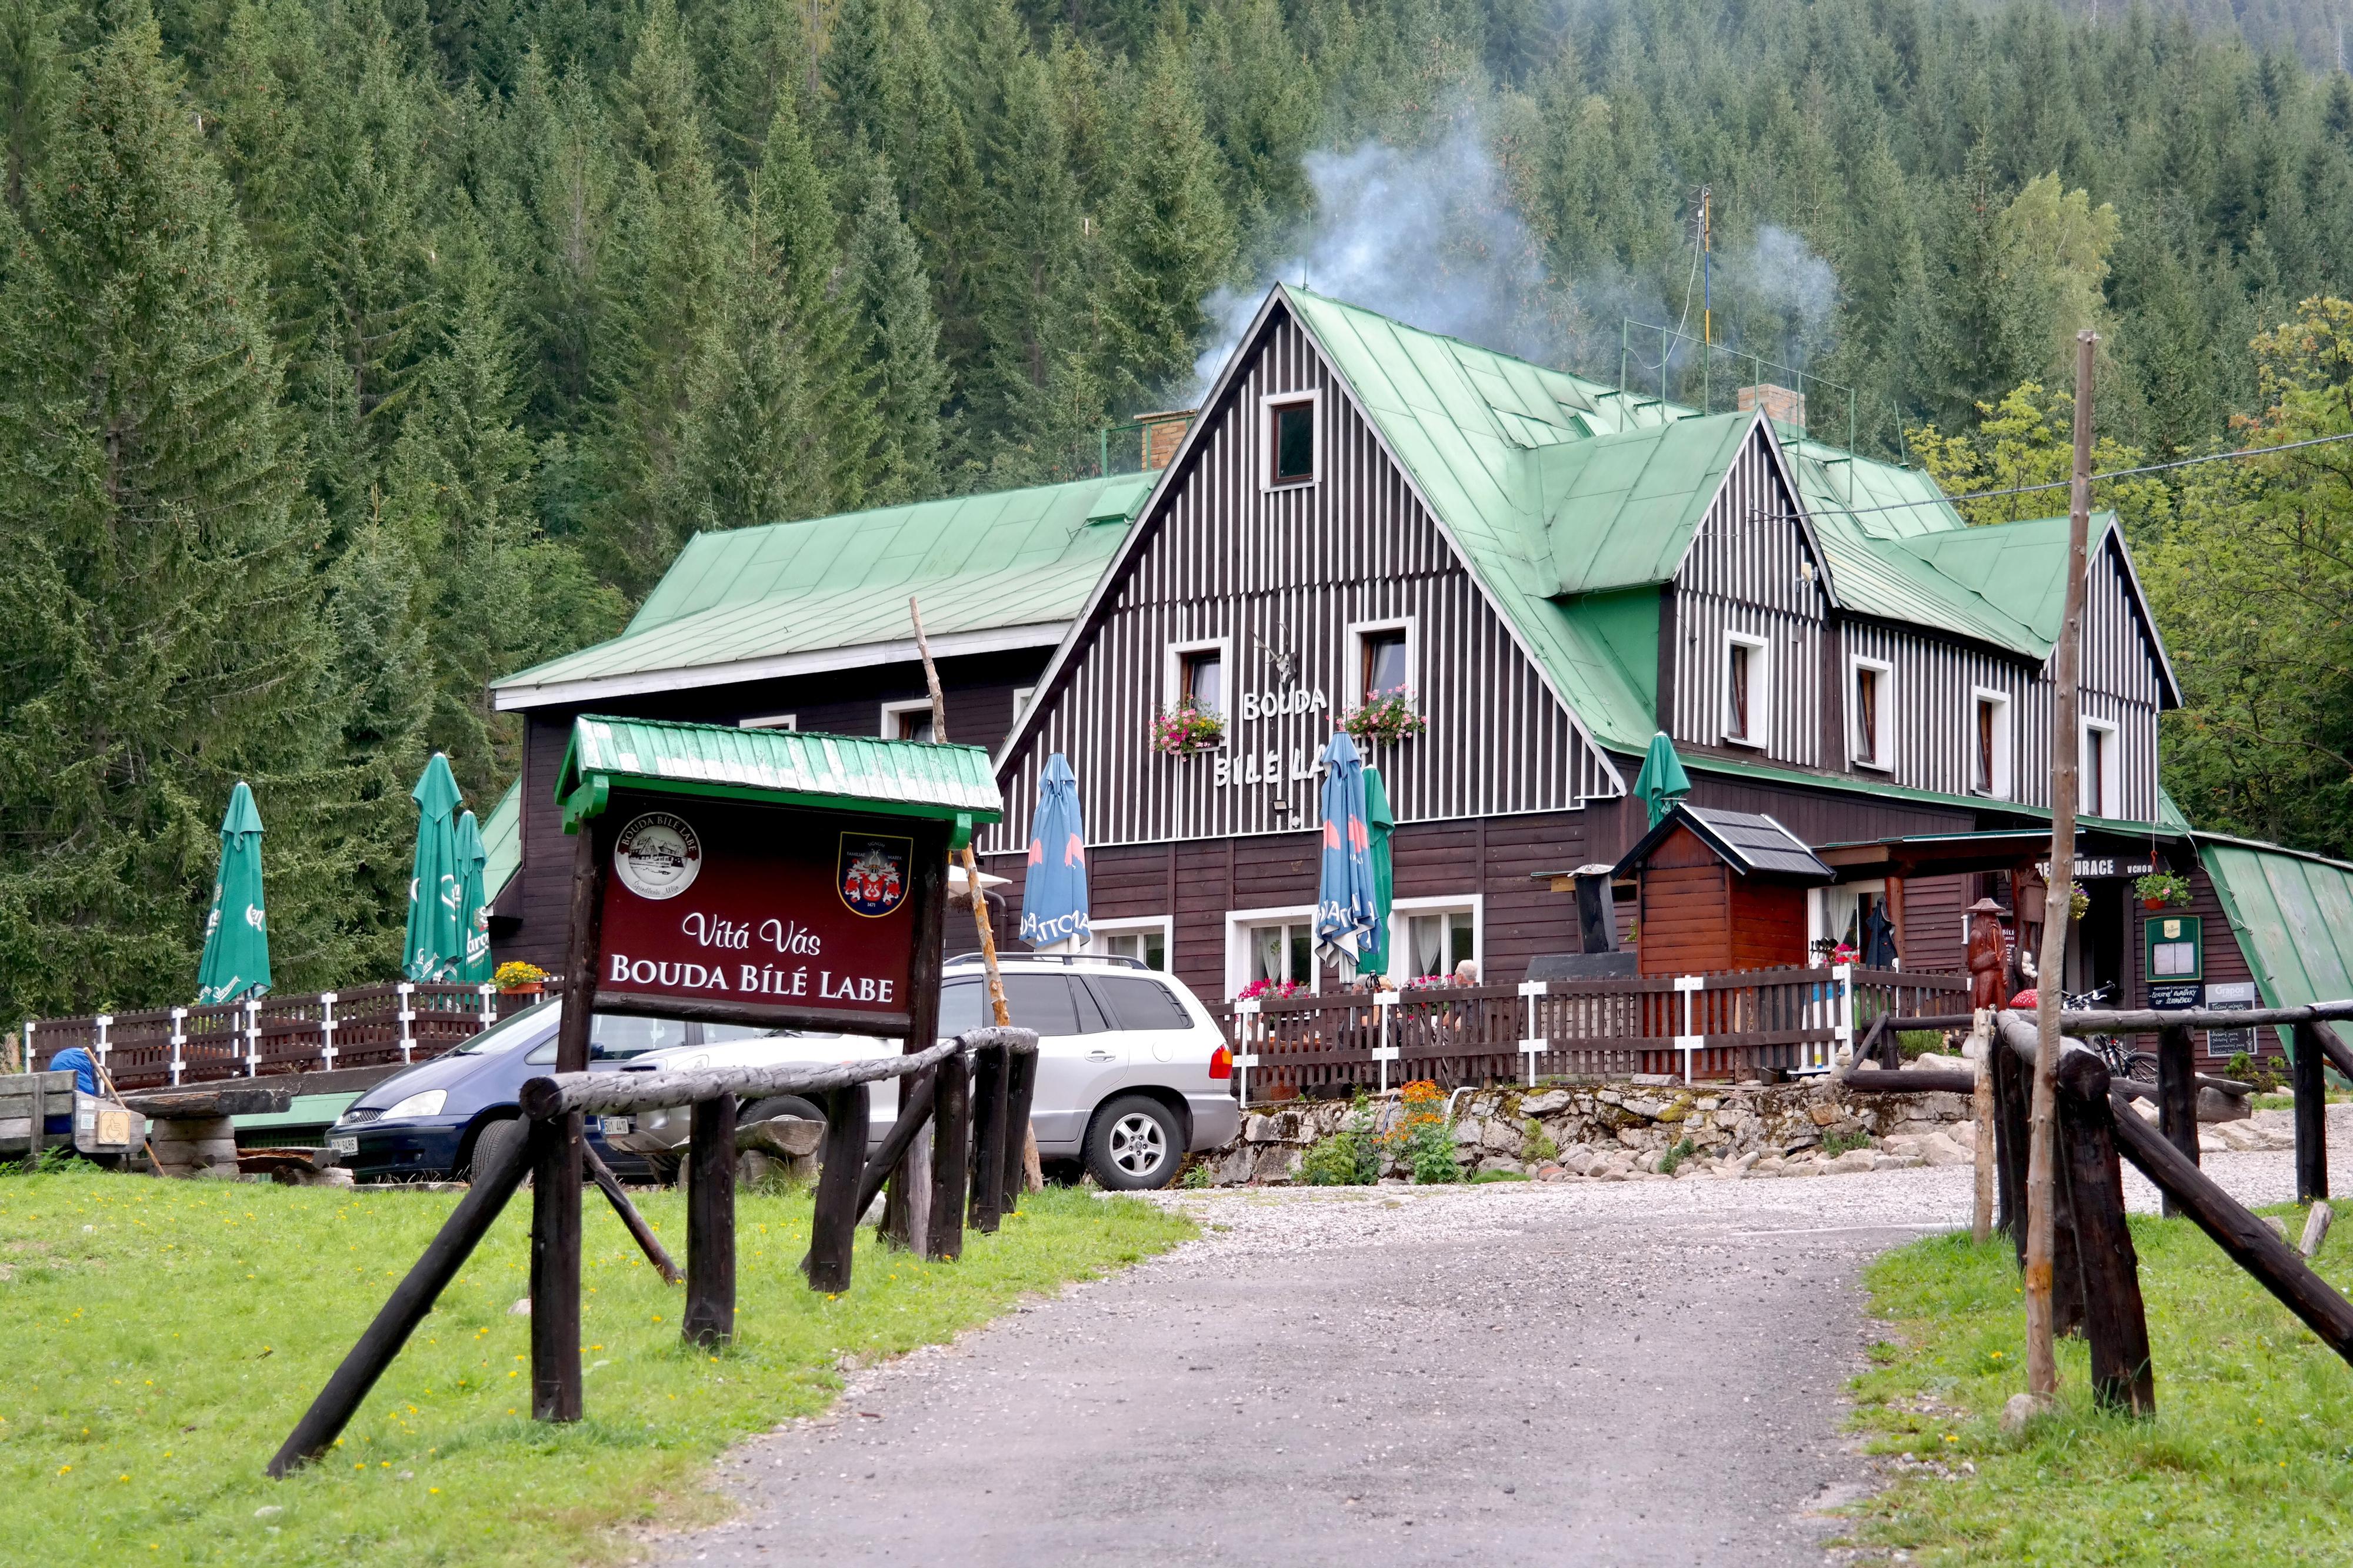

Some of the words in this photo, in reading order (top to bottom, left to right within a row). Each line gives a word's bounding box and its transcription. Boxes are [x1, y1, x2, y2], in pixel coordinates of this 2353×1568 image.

[1243, 687, 1327, 720] BOUDA
[1215, 749, 1279, 787] BÍLÉ
[621, 817, 654, 846] BOUDA
[657, 815, 680, 829] BÍLÉ
[679, 827, 697, 852] LABE
[2035, 859, 2113, 877] REURACE
[2127, 865, 2153, 874] VCHOD
[682, 912, 749, 950] Vítá
[759, 918, 821, 956] Vás
[609, 954, 730, 990] BOUDA
[739, 963, 808, 996] BÍLÉ
[819, 970, 894, 1003] LABE
